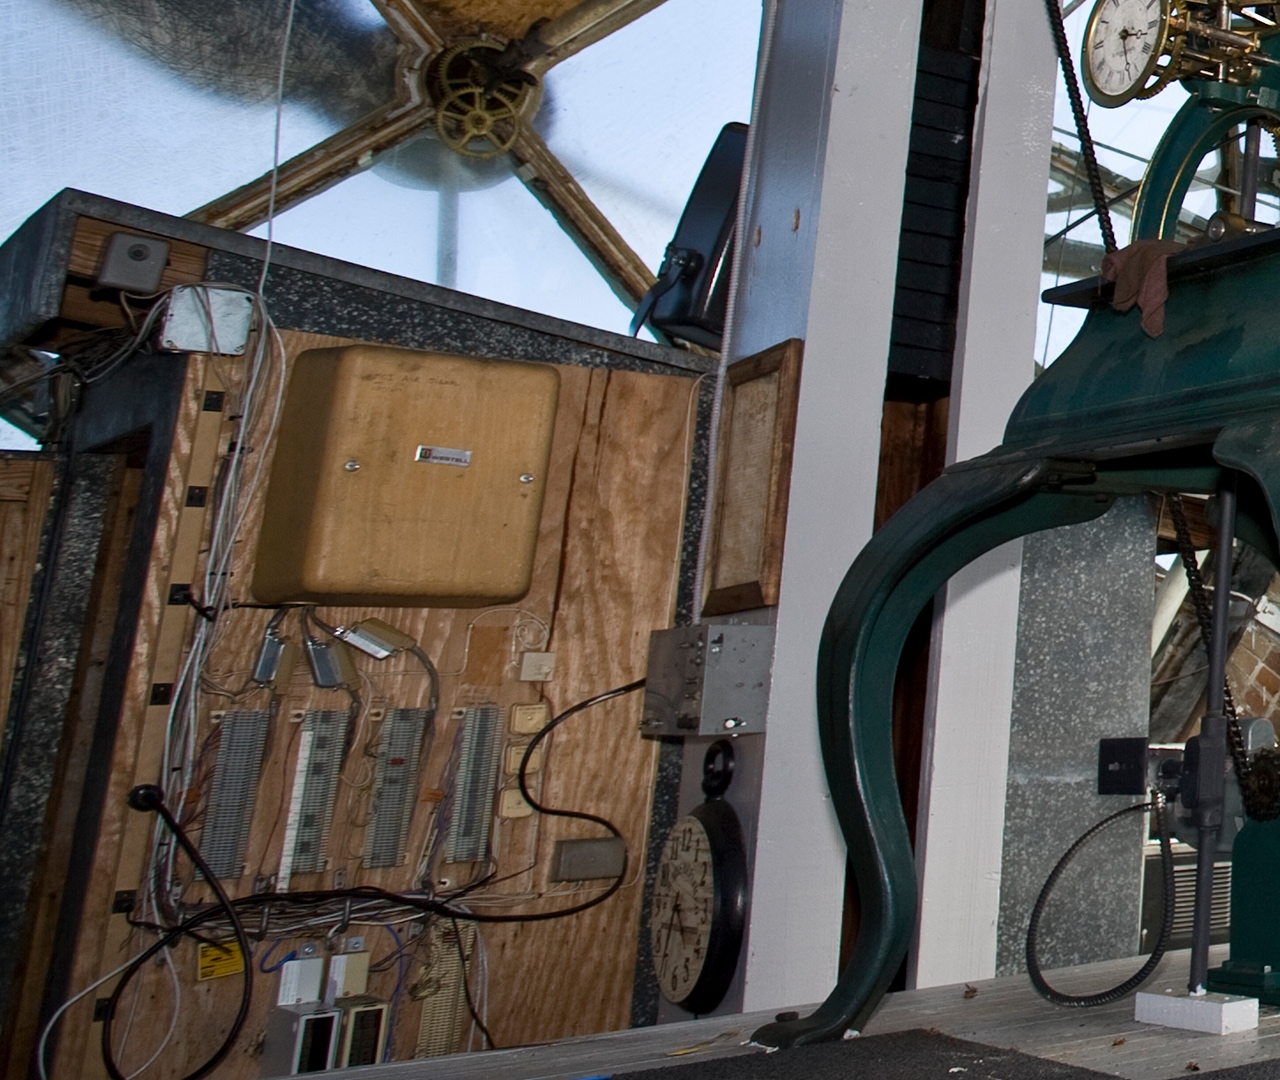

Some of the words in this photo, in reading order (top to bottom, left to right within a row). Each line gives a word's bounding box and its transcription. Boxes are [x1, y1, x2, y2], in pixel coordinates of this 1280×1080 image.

[681, 826, 693, 852] 12
[699, 860, 708, 887] 2
[671, 964, 679, 992] 6
[683, 956, 691, 984] 5
